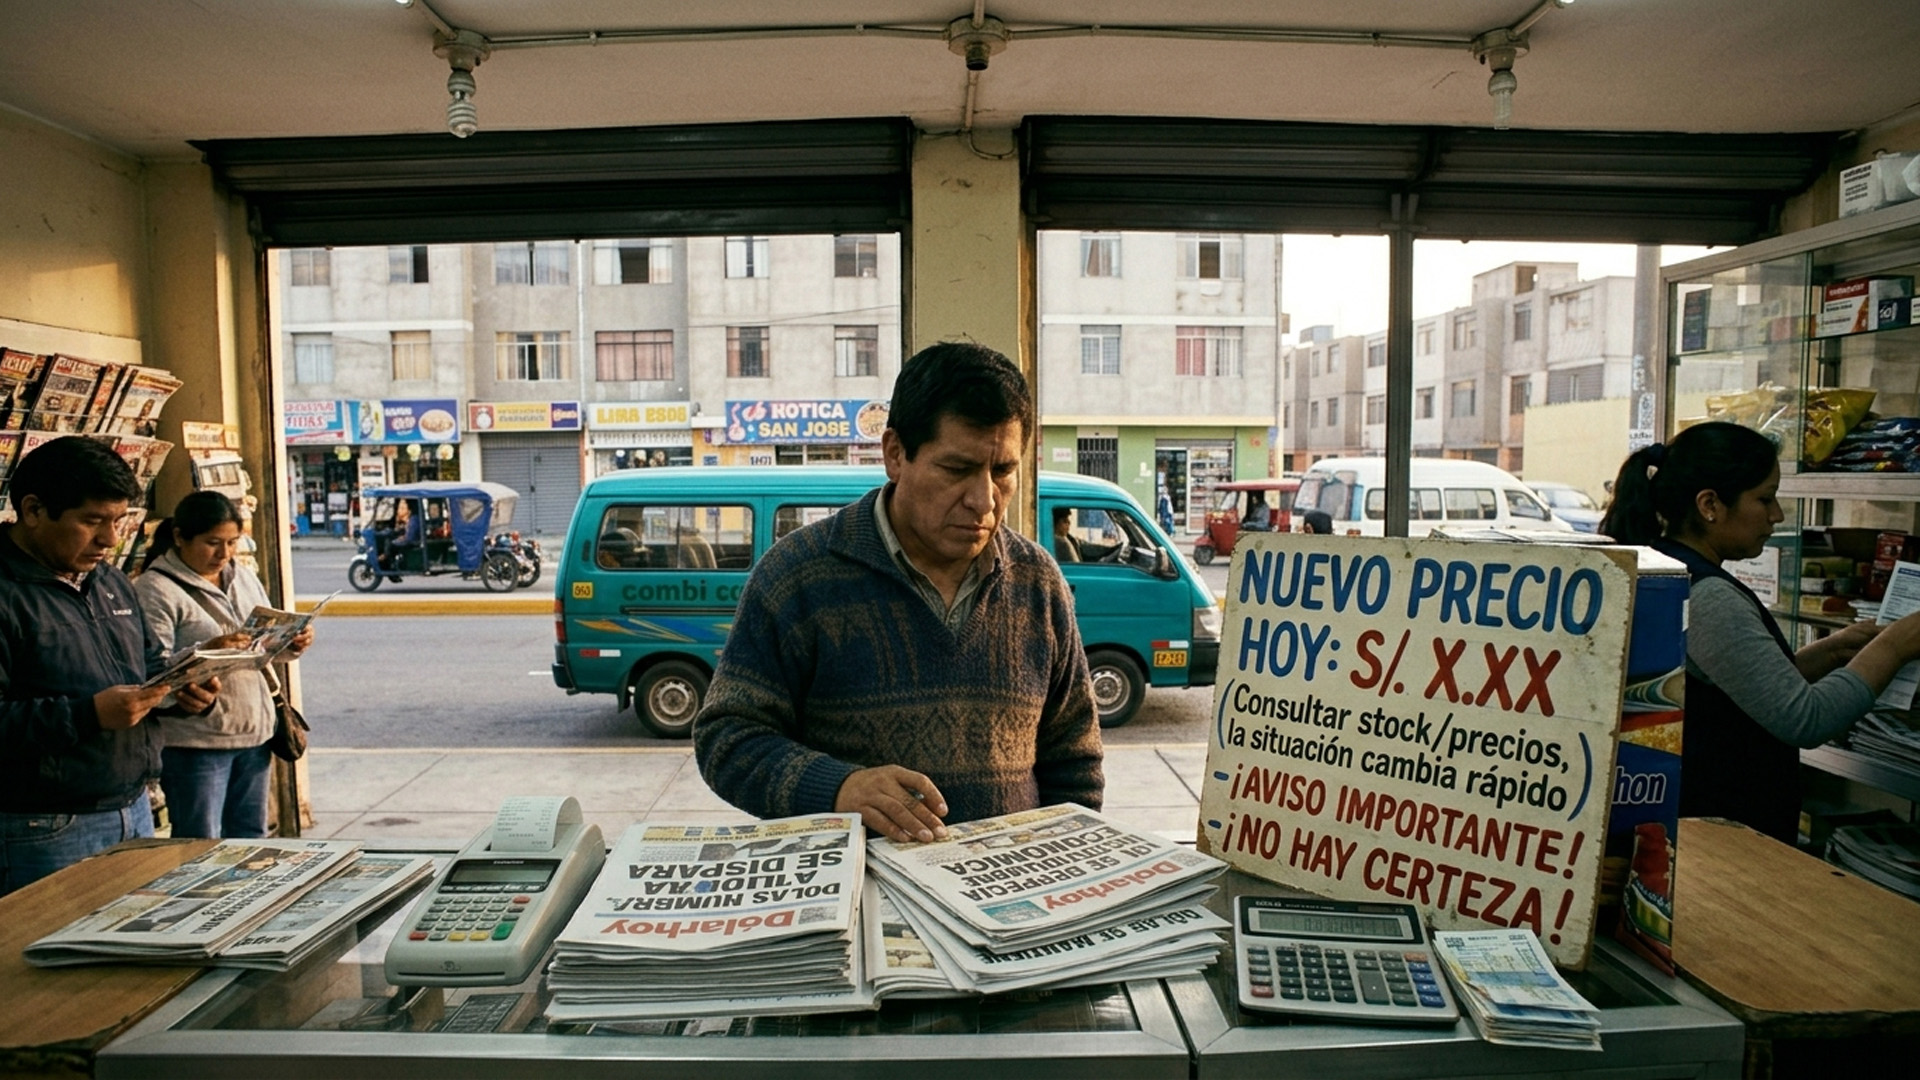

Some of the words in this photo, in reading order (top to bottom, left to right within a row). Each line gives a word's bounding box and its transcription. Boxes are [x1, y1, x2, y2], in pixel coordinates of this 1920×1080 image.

[759, 422, 798, 438] SAN
[802, 421, 850, 437] JOSE
[622, 580, 706, 601] combi
[1239, 549, 1390, 615] NUEVO
[1407, 558, 1603, 635] PRECIO
[1238, 617, 1341, 681] HOY:
[1350, 629, 1410, 697] S/.
[1424, 637, 1561, 717] X.XX
[1228, 719, 1246, 747] la
[1250, 727, 1354, 769] situación
[1360, 750, 1457, 790] cambia
[1358, 712, 1569, 773] stock/precios,
[1289, 828, 1359, 881] HAY
[1335, 785, 1585, 880] IMPORTANTE!
[629, 857, 785, 880] DISPARA
[797, 851, 843, 870] SE
[600, 910, 796, 939] Dólarhoy
